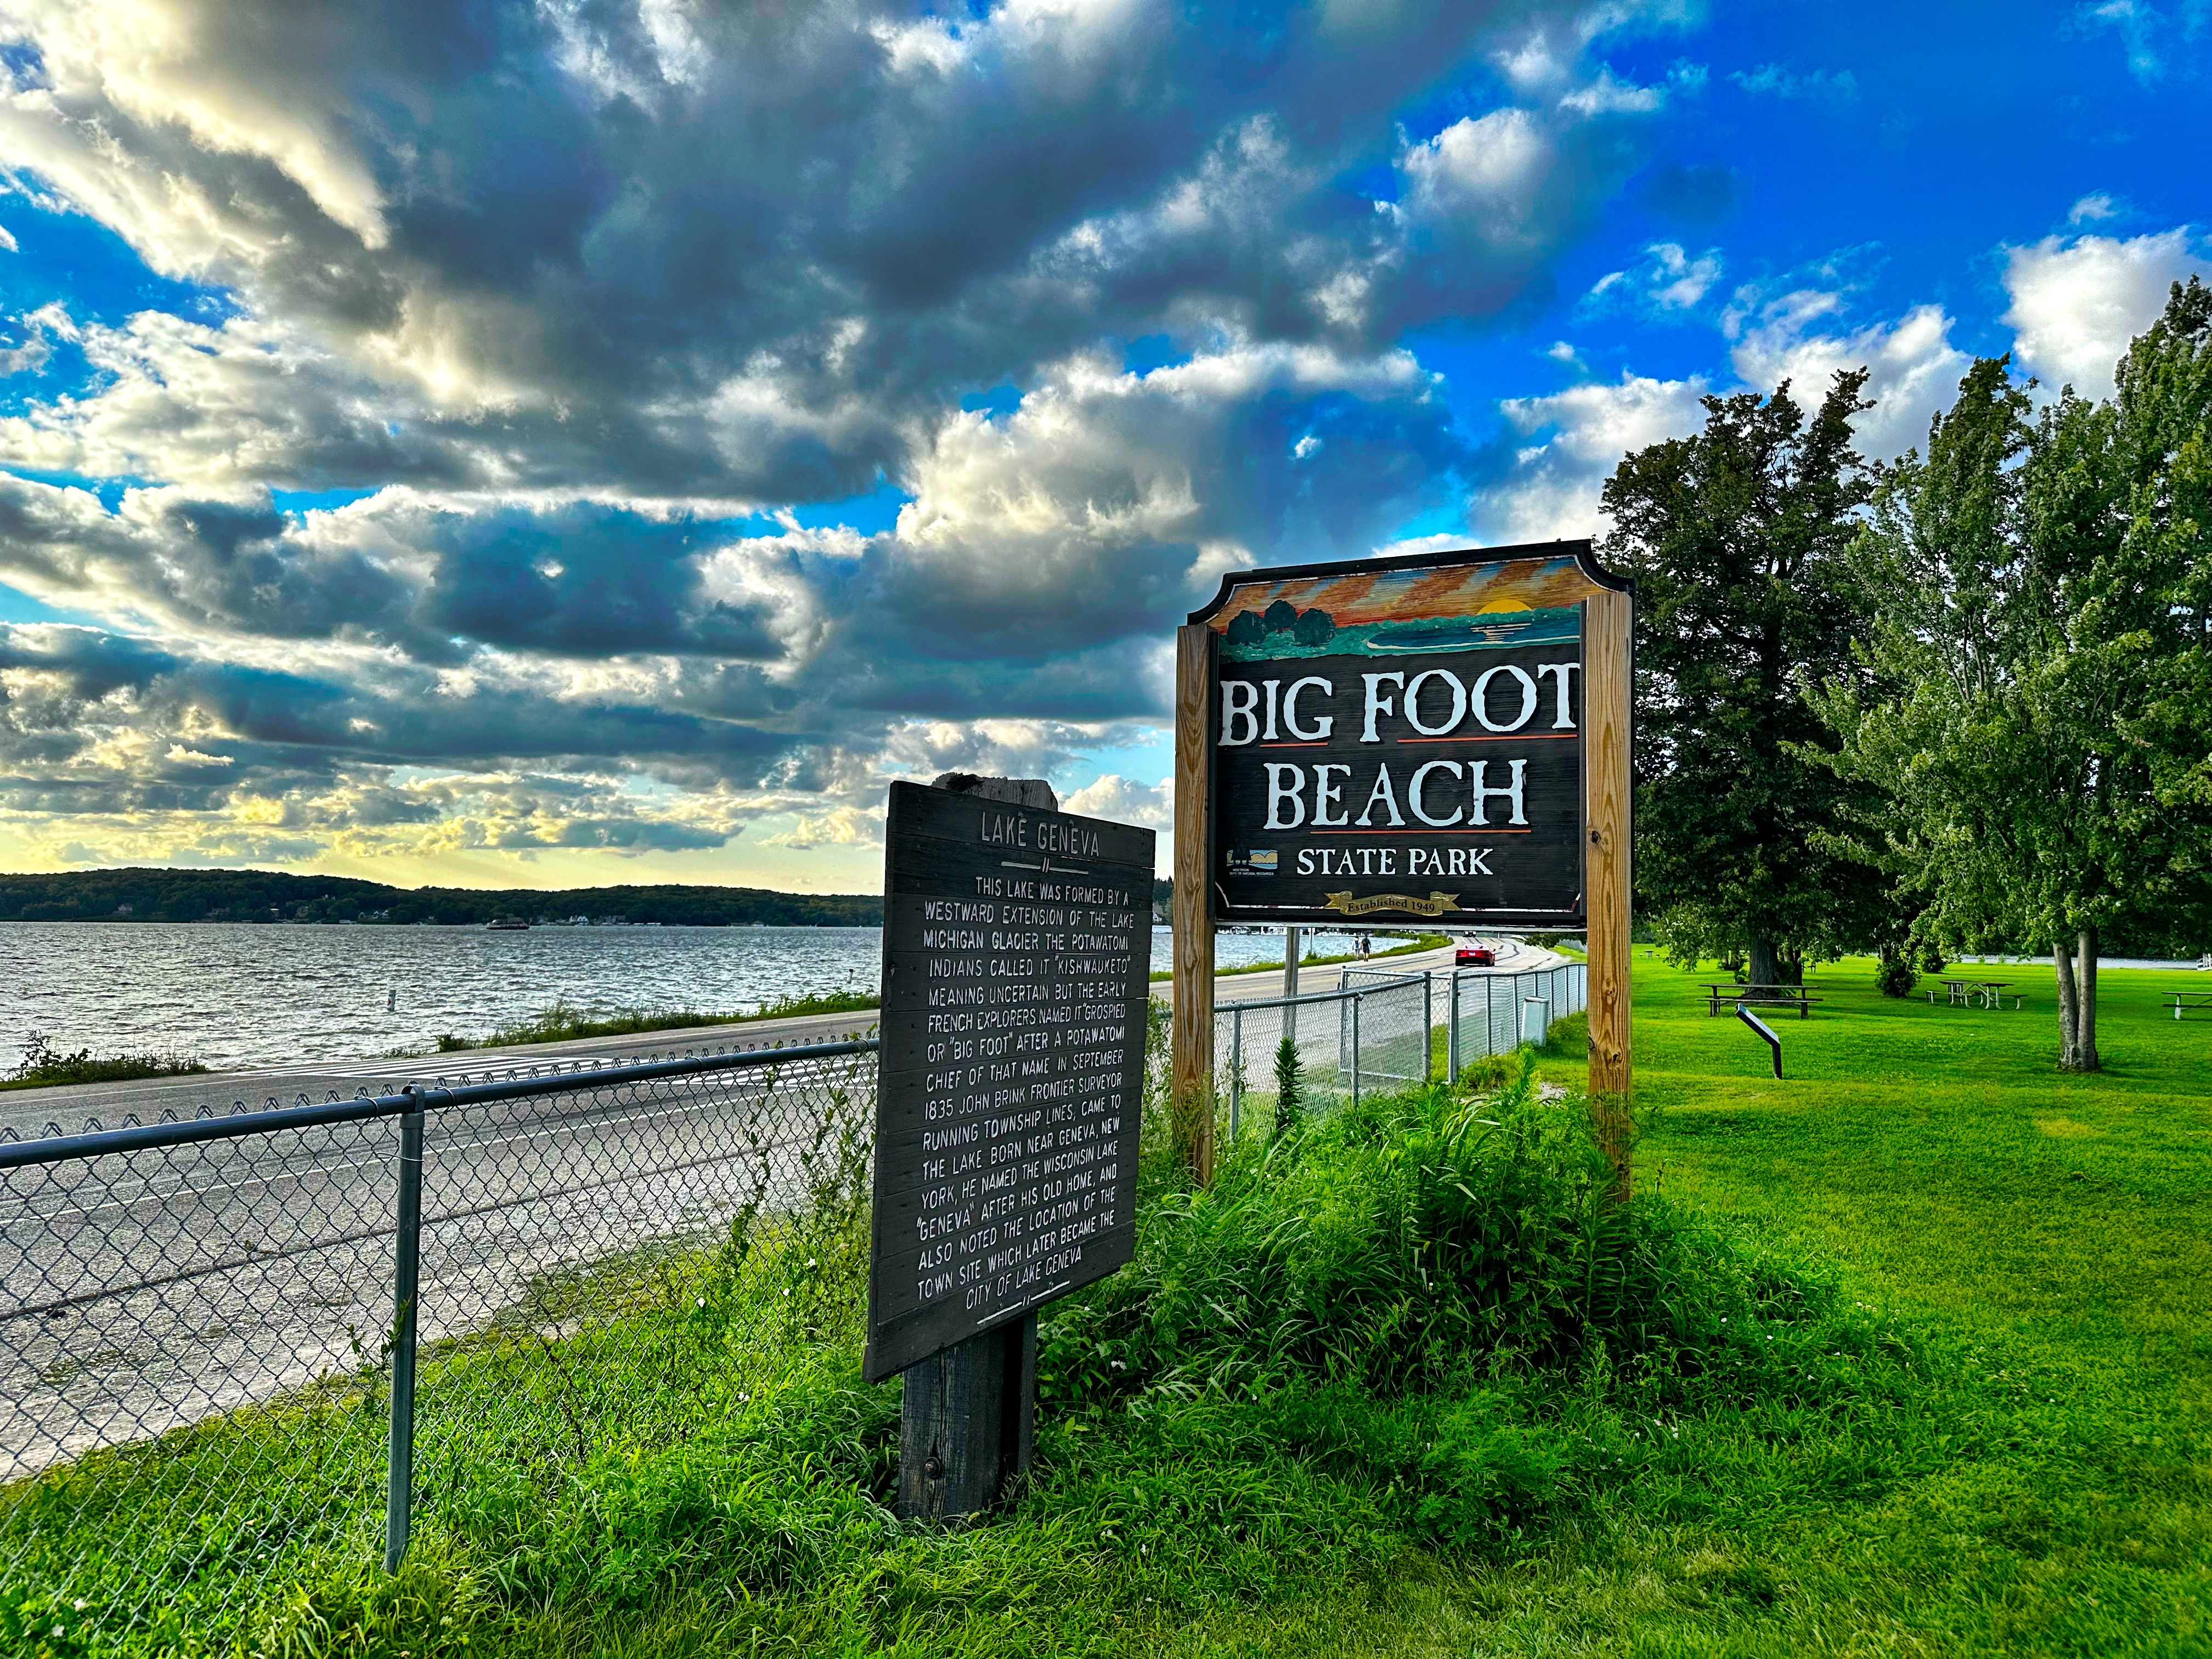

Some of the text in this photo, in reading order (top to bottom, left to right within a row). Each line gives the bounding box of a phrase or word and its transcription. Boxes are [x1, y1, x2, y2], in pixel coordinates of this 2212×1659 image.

[1217, 663, 1579, 746] BIG FOOT
[1263, 759, 1529, 830] BEACH
[981, 811, 1099, 857] LAKE GENEVA
[1297, 848, 1493, 876] STATE PARK
[975, 876, 1128, 906] THIS LAKE WAS FORMED BY A
[1347, 898, 1435, 912] Established 1949
[925, 900, 1134, 929] WESTWARD EXTENSION OF THE LAKE
[923, 928, 1128, 951] MICHIGAN GLACIER THE POTAWATOMI
[929, 959, 982, 977] INDIANS
[990, 958, 1033, 977] CALLED
[1040, 958, 1049, 974] IT
[929, 981, 1126, 1006] MEANING UNCERTAIN BUT THE EARLY
[928, 1013, 973, 1034] FRENCH
[977, 1008, 1036, 1030] EXPLORERS
[1039, 1007, 1071, 1024] NAMED
[1074, 1005, 1082, 1020] IT
[927, 1043, 944, 1063] OR
[1017, 1032, 1048, 1052] AFTER
[1054, 1031, 1061, 1046] A
[1067, 1025, 1125, 1046] POTAWATOMI
[927, 1049, 1124, 1092] CHIEF OF THAT NAME IN SEPTEMBER
[925, 1072, 1122, 1120] 1835 JOHN BRINK FRONTIER SURVEYOR
[923, 1094, 1121, 1151] RUNNING TOWNSHIP LINES, CAME TO
[923, 1117, 1120, 1181] THE LAKE BORN NEAR GENEVA, NEW
[922, 1140, 1118, 1210] YORK, HE NAMED THE WISCONSIN LAKE
[981, 1193, 1015, 1221] AFTER
[1021, 1187, 1037, 1206] HIS
[1043, 1180, 1062, 1201] OLD
[1066, 1172, 1096, 1194] HOME,
[1100, 1163, 1117, 1183] AND
[918, 1186, 1116, 1270] ALSO NOTED THE LOCATION OF THE
[918, 1209, 1115, 1300] TOWN SITE WHICH LATER BECAME THE
[966, 1246, 1082, 1310] CITY OF LAKE GENEVA
